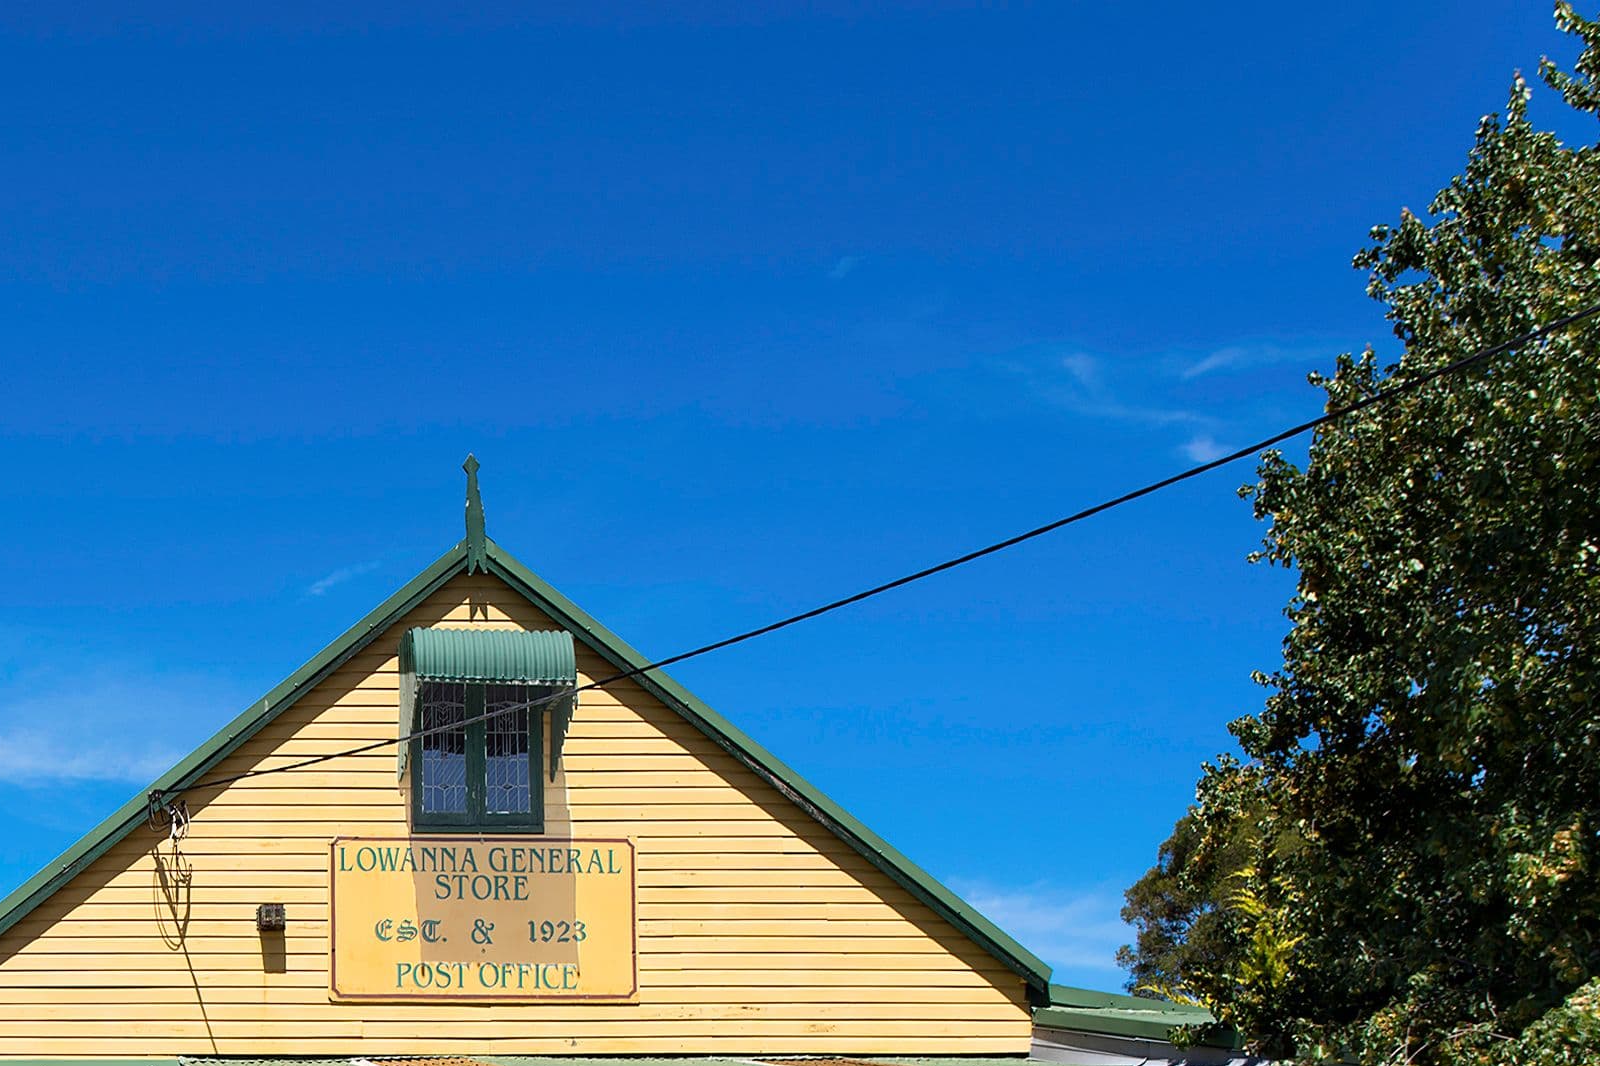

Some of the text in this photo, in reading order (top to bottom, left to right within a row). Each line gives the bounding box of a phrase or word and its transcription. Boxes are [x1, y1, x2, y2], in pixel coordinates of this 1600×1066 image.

[339, 846, 622, 874] LOWANNA GENERAL
[435, 874, 530, 901] STORE
[375, 918, 588, 945] EST. & 1923
[396, 961, 579, 990] POST OFFICE
